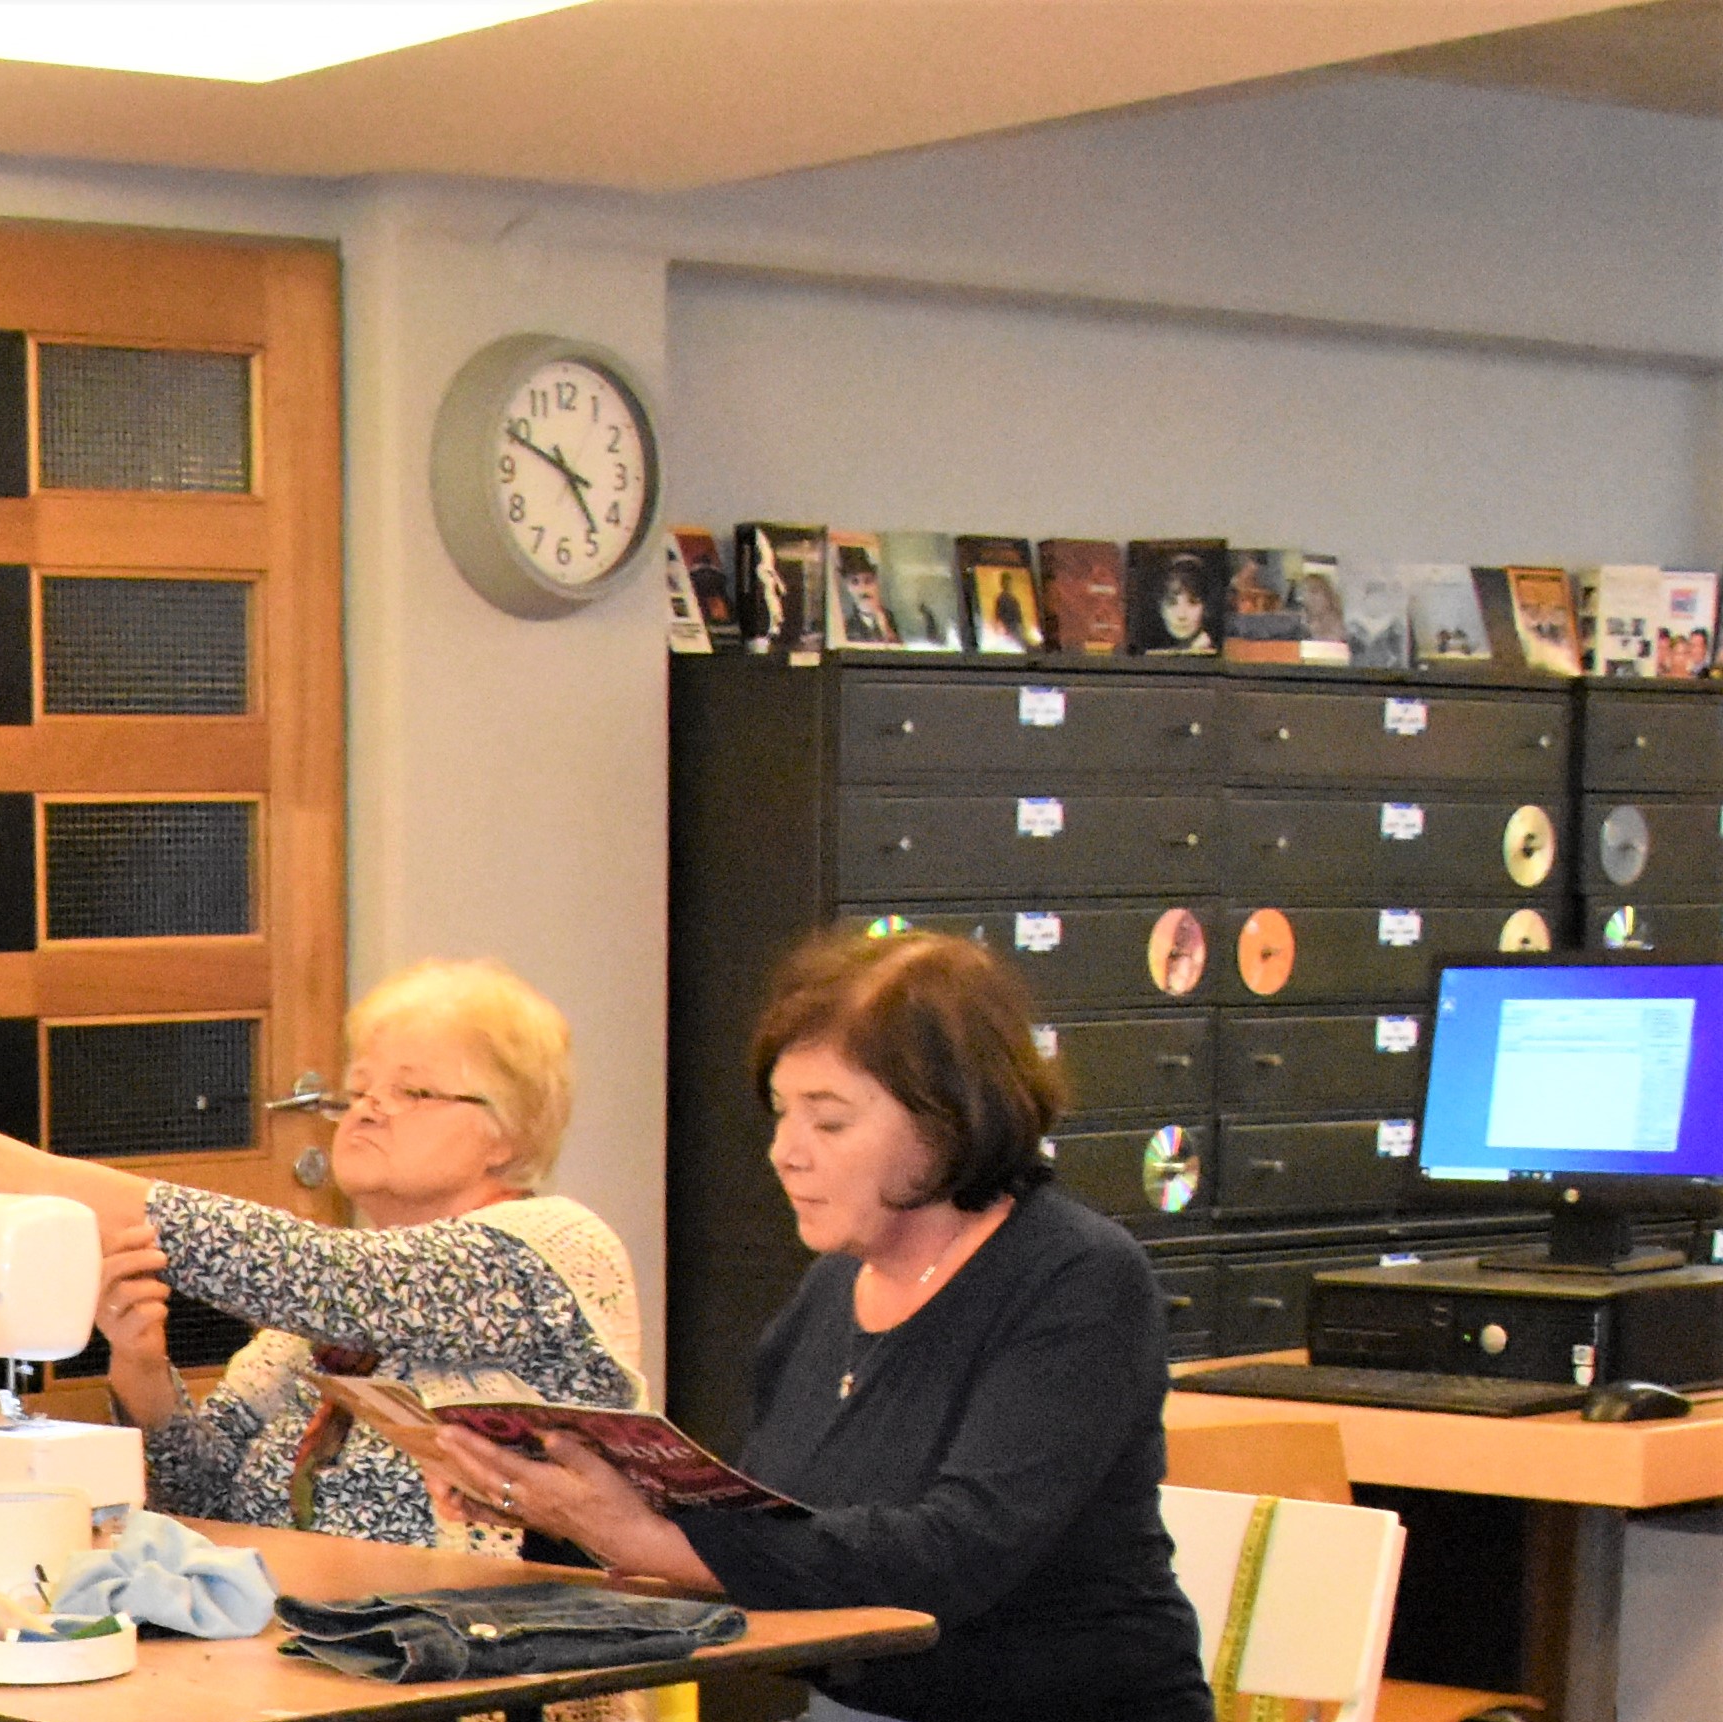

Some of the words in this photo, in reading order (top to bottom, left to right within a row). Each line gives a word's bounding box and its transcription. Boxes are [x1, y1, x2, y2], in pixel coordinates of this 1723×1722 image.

[530, 389, 549, 418] 11
[556, 382, 577, 411] 12
[590, 395, 600, 422] 1
[607, 425, 621, 453] 2
[500, 456, 515, 484] 9
[614, 462, 628, 491] 3
[509, 493, 525, 523] 8
[605, 501, 621, 527] 4
[530, 526, 546, 554] 7
[556, 537, 571, 565] 6
[584, 529, 599, 557] 5
